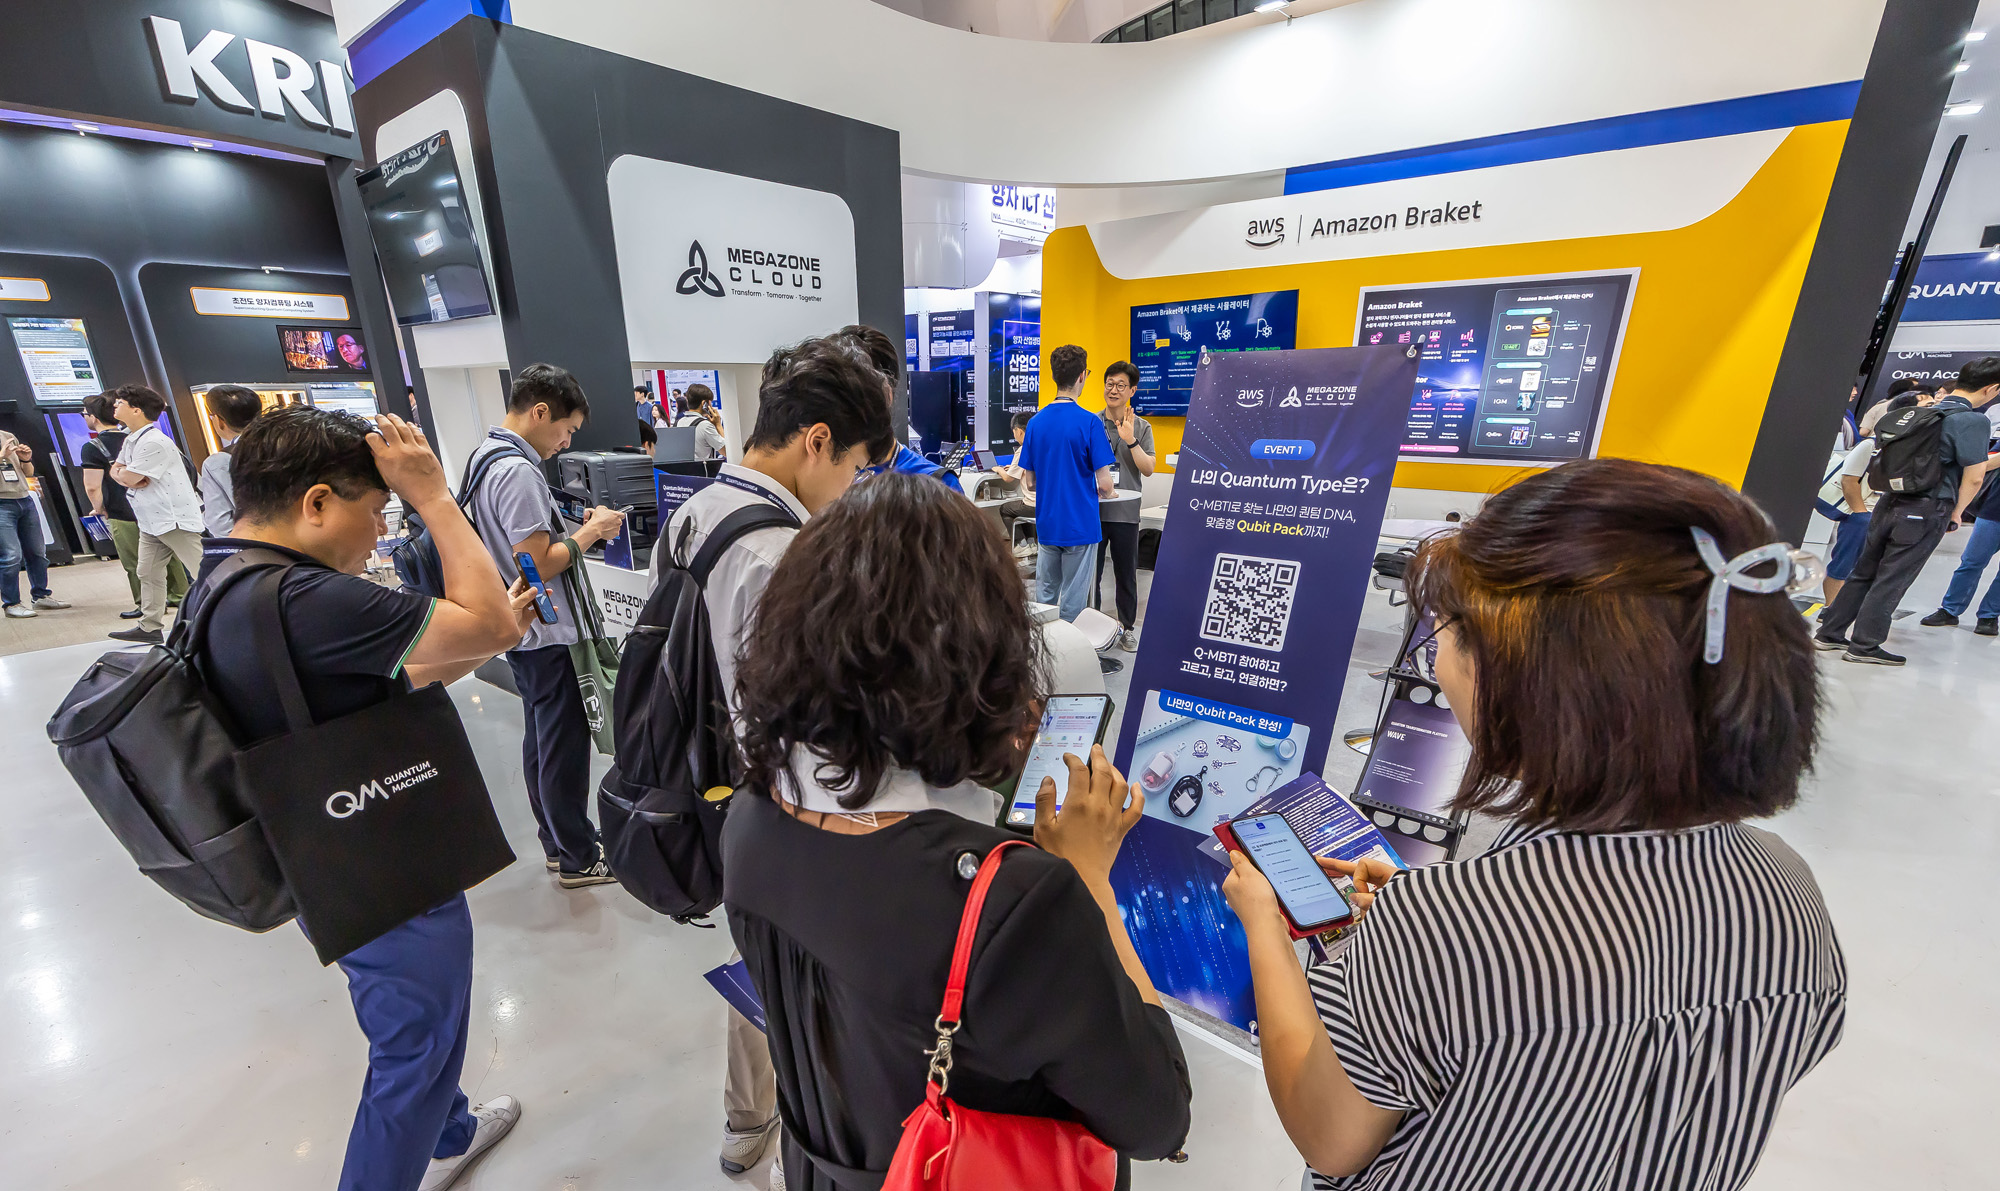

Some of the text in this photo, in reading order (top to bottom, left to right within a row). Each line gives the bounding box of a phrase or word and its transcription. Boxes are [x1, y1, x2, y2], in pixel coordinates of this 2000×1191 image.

[149, 15, 355, 134] KRI
[992, 185, 1055, 219] 양자 ICT 산
[1247, 200, 1482, 238] aws Amazon Braket
[728, 248, 820, 272] MEGAZONE
[729, 266, 822, 290] CLOUD
[256, 298, 292, 306] 양자컴퓨팅
[731, 288, 822, 302] Transform Tomorrow Together
[1160, 306, 1189, 316] Braket에서
[1191, 304, 1215, 313] 제공하는
[1217, 299, 1250, 311] 시뮬레이터
[1013, 336, 1022, 344] 양자
[1009, 354, 1040, 372] 산업으
[1892, 370, 1930, 379] Open
[1238, 389, 1264, 400] aws
[1264, 445, 1302, 455] EVENT 1
[1191, 470, 1370, 495] 나의 Quantum Type은?
[1190, 498, 1356, 523] Q-MBTI로 찾는 나만의 퀀텀 DNA,
[1206, 517, 1330, 539] 맞춤형 Qubit Pack까지!
[603, 588, 647, 608] MEGAZON
[1194, 647, 1281, 674] Q-MBTI 참여하고
[1180, 660, 1288, 692] 고르고, 담고, 연결하면?
[1167, 696, 1283, 733] 나만의 Qubit Pack 완성!
[1387, 730, 1406, 741] WAVE
[384, 761, 431, 785] QUANTUM
[392, 768, 438, 793] MACHINES
[326, 779, 389, 818] QM
